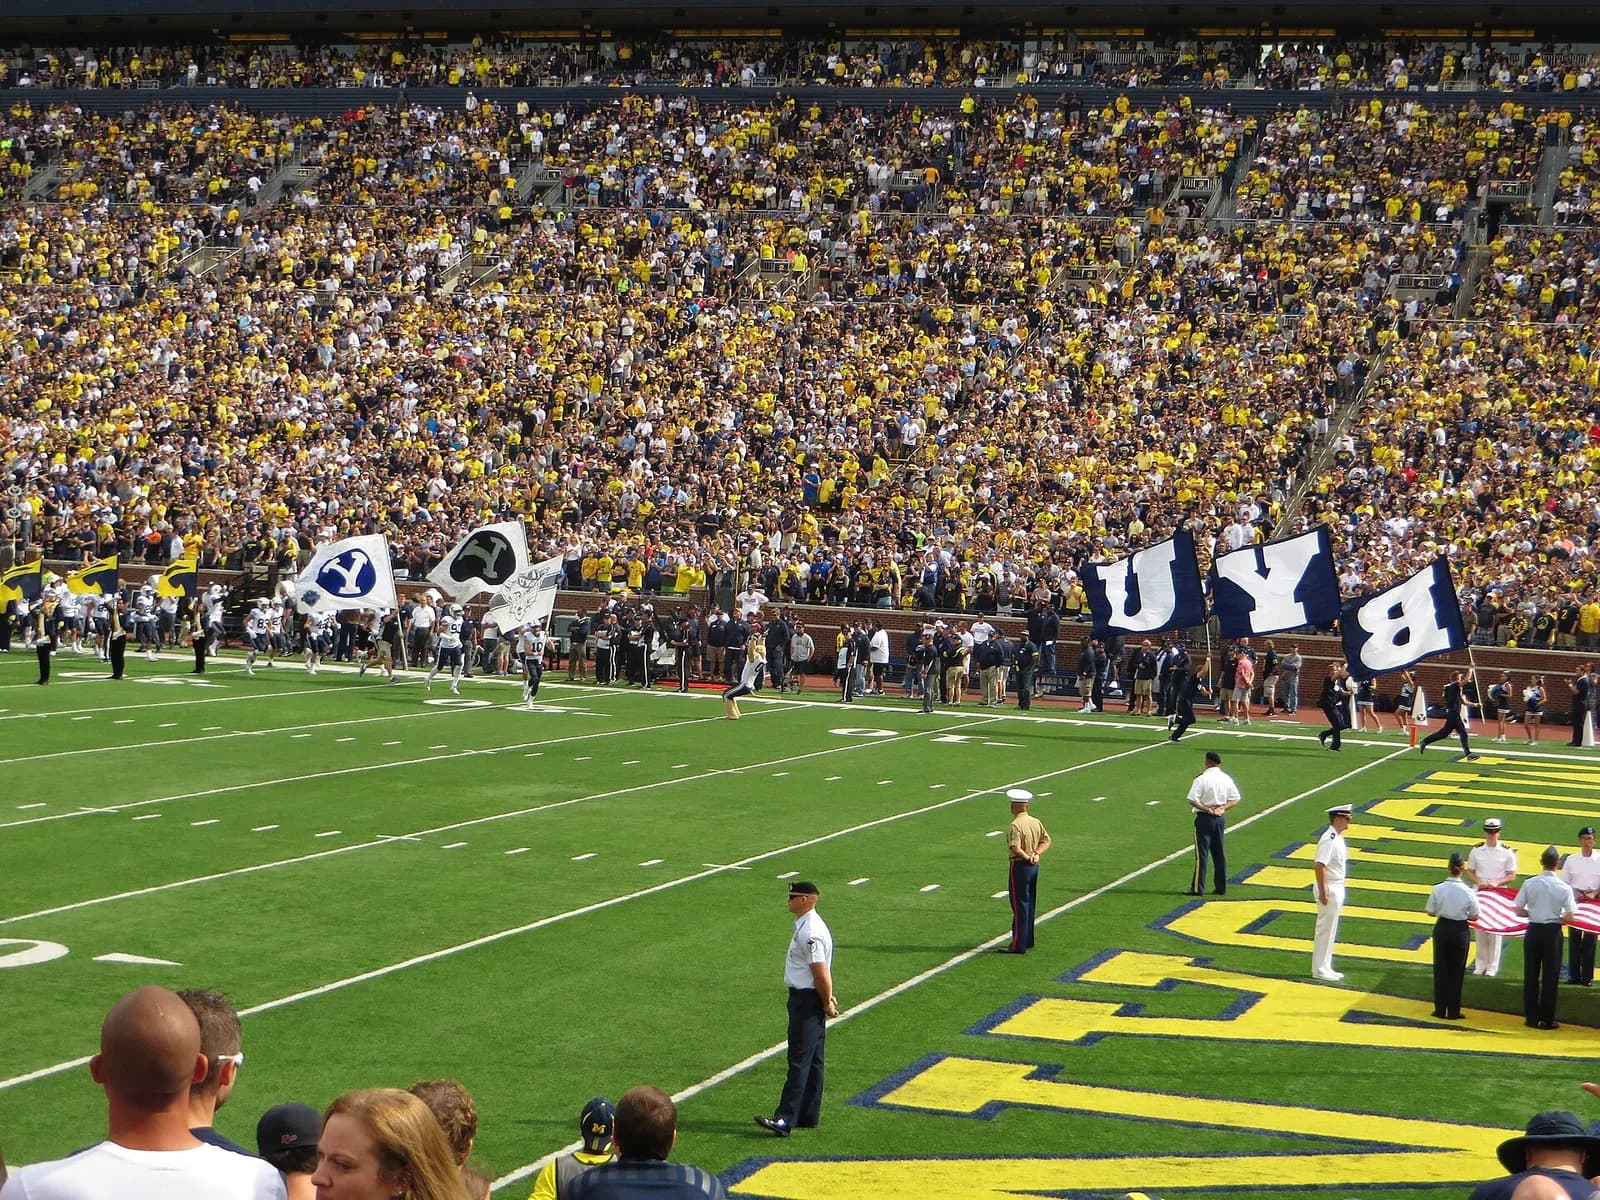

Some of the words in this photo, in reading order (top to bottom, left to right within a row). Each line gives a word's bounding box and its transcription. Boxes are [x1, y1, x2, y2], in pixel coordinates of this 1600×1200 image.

[501, 502, 507, 512] 3
[322, 551, 368, 593] Y
[1561, 609, 1568, 620] 2
[531, 641, 543, 653] 10
[591, 1122, 606, 1134] M
